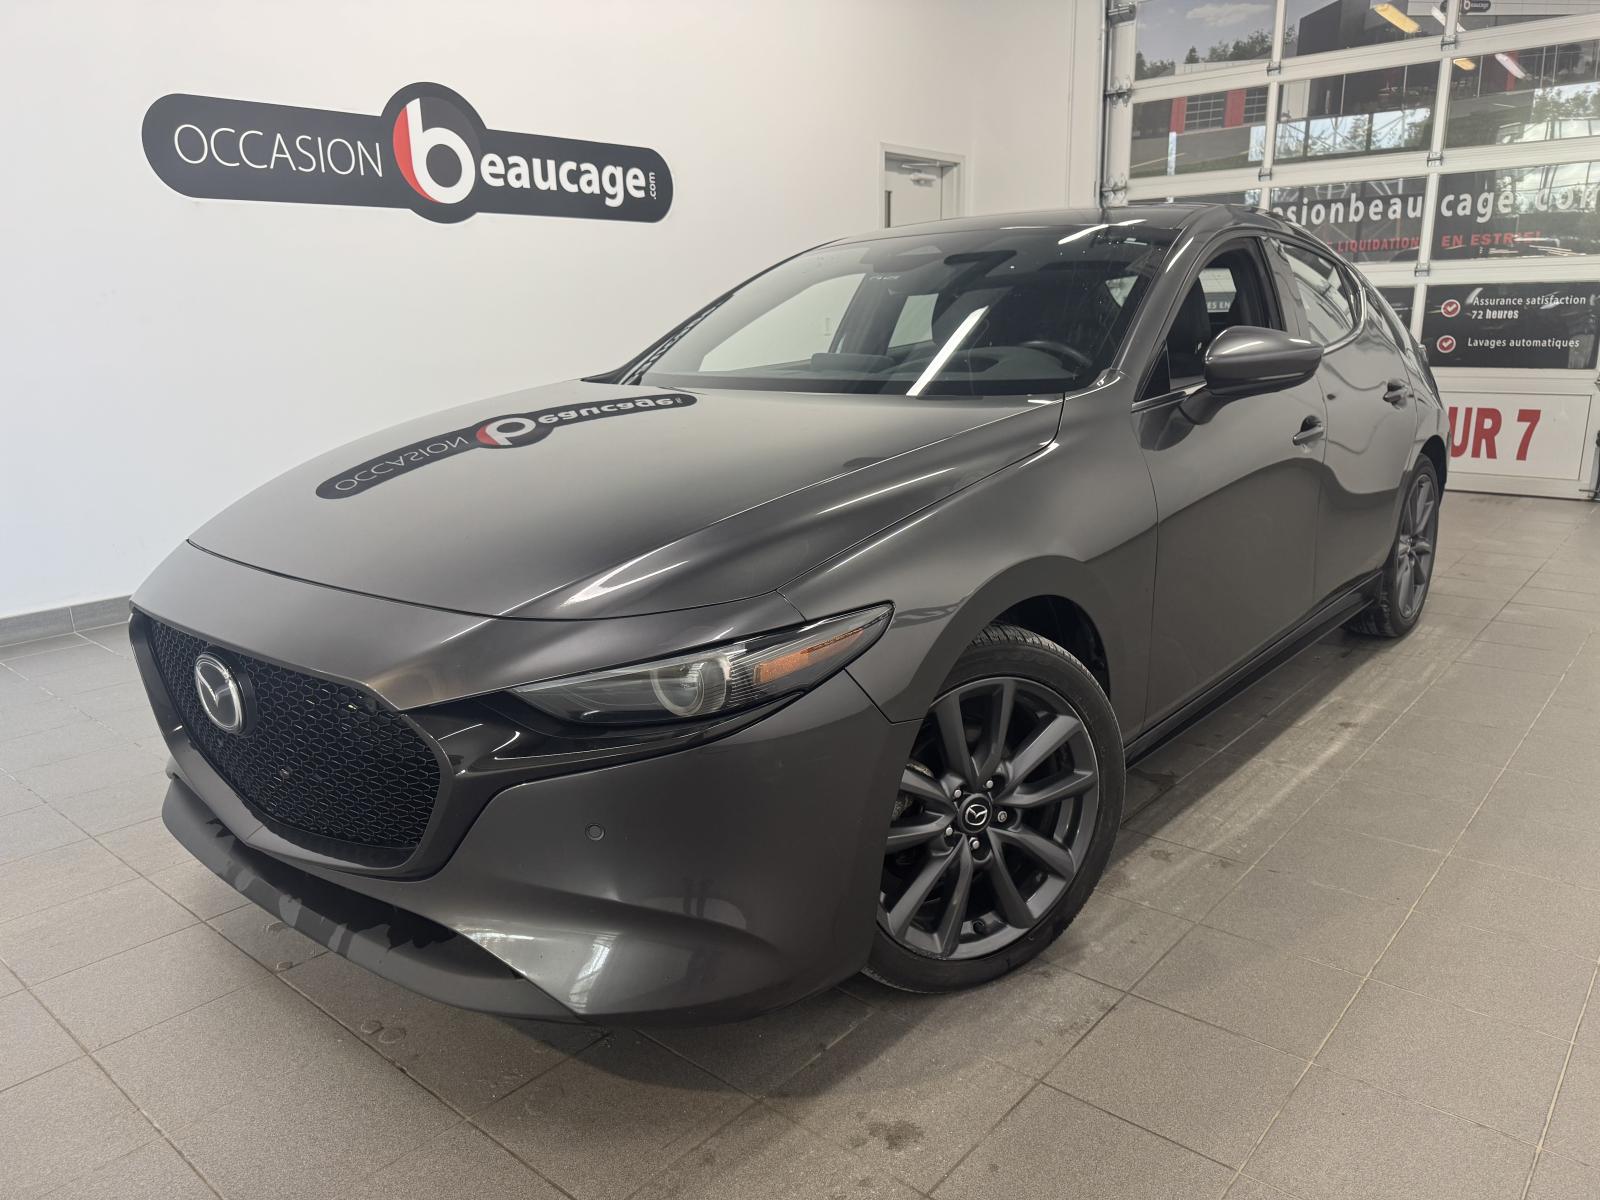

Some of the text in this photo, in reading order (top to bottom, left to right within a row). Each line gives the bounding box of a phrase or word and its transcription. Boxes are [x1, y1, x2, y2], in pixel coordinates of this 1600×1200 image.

[173, 122, 384, 179] OCCASION
[1441, 233, 1465, 248] EN
[1472, 294, 1587, 306] Assurance satisfaction
[1471, 309, 1519, 319] 72 heures
[1467, 337, 1580, 349] Lavages automatiques
[1516, 408, 1542, 461] 7
